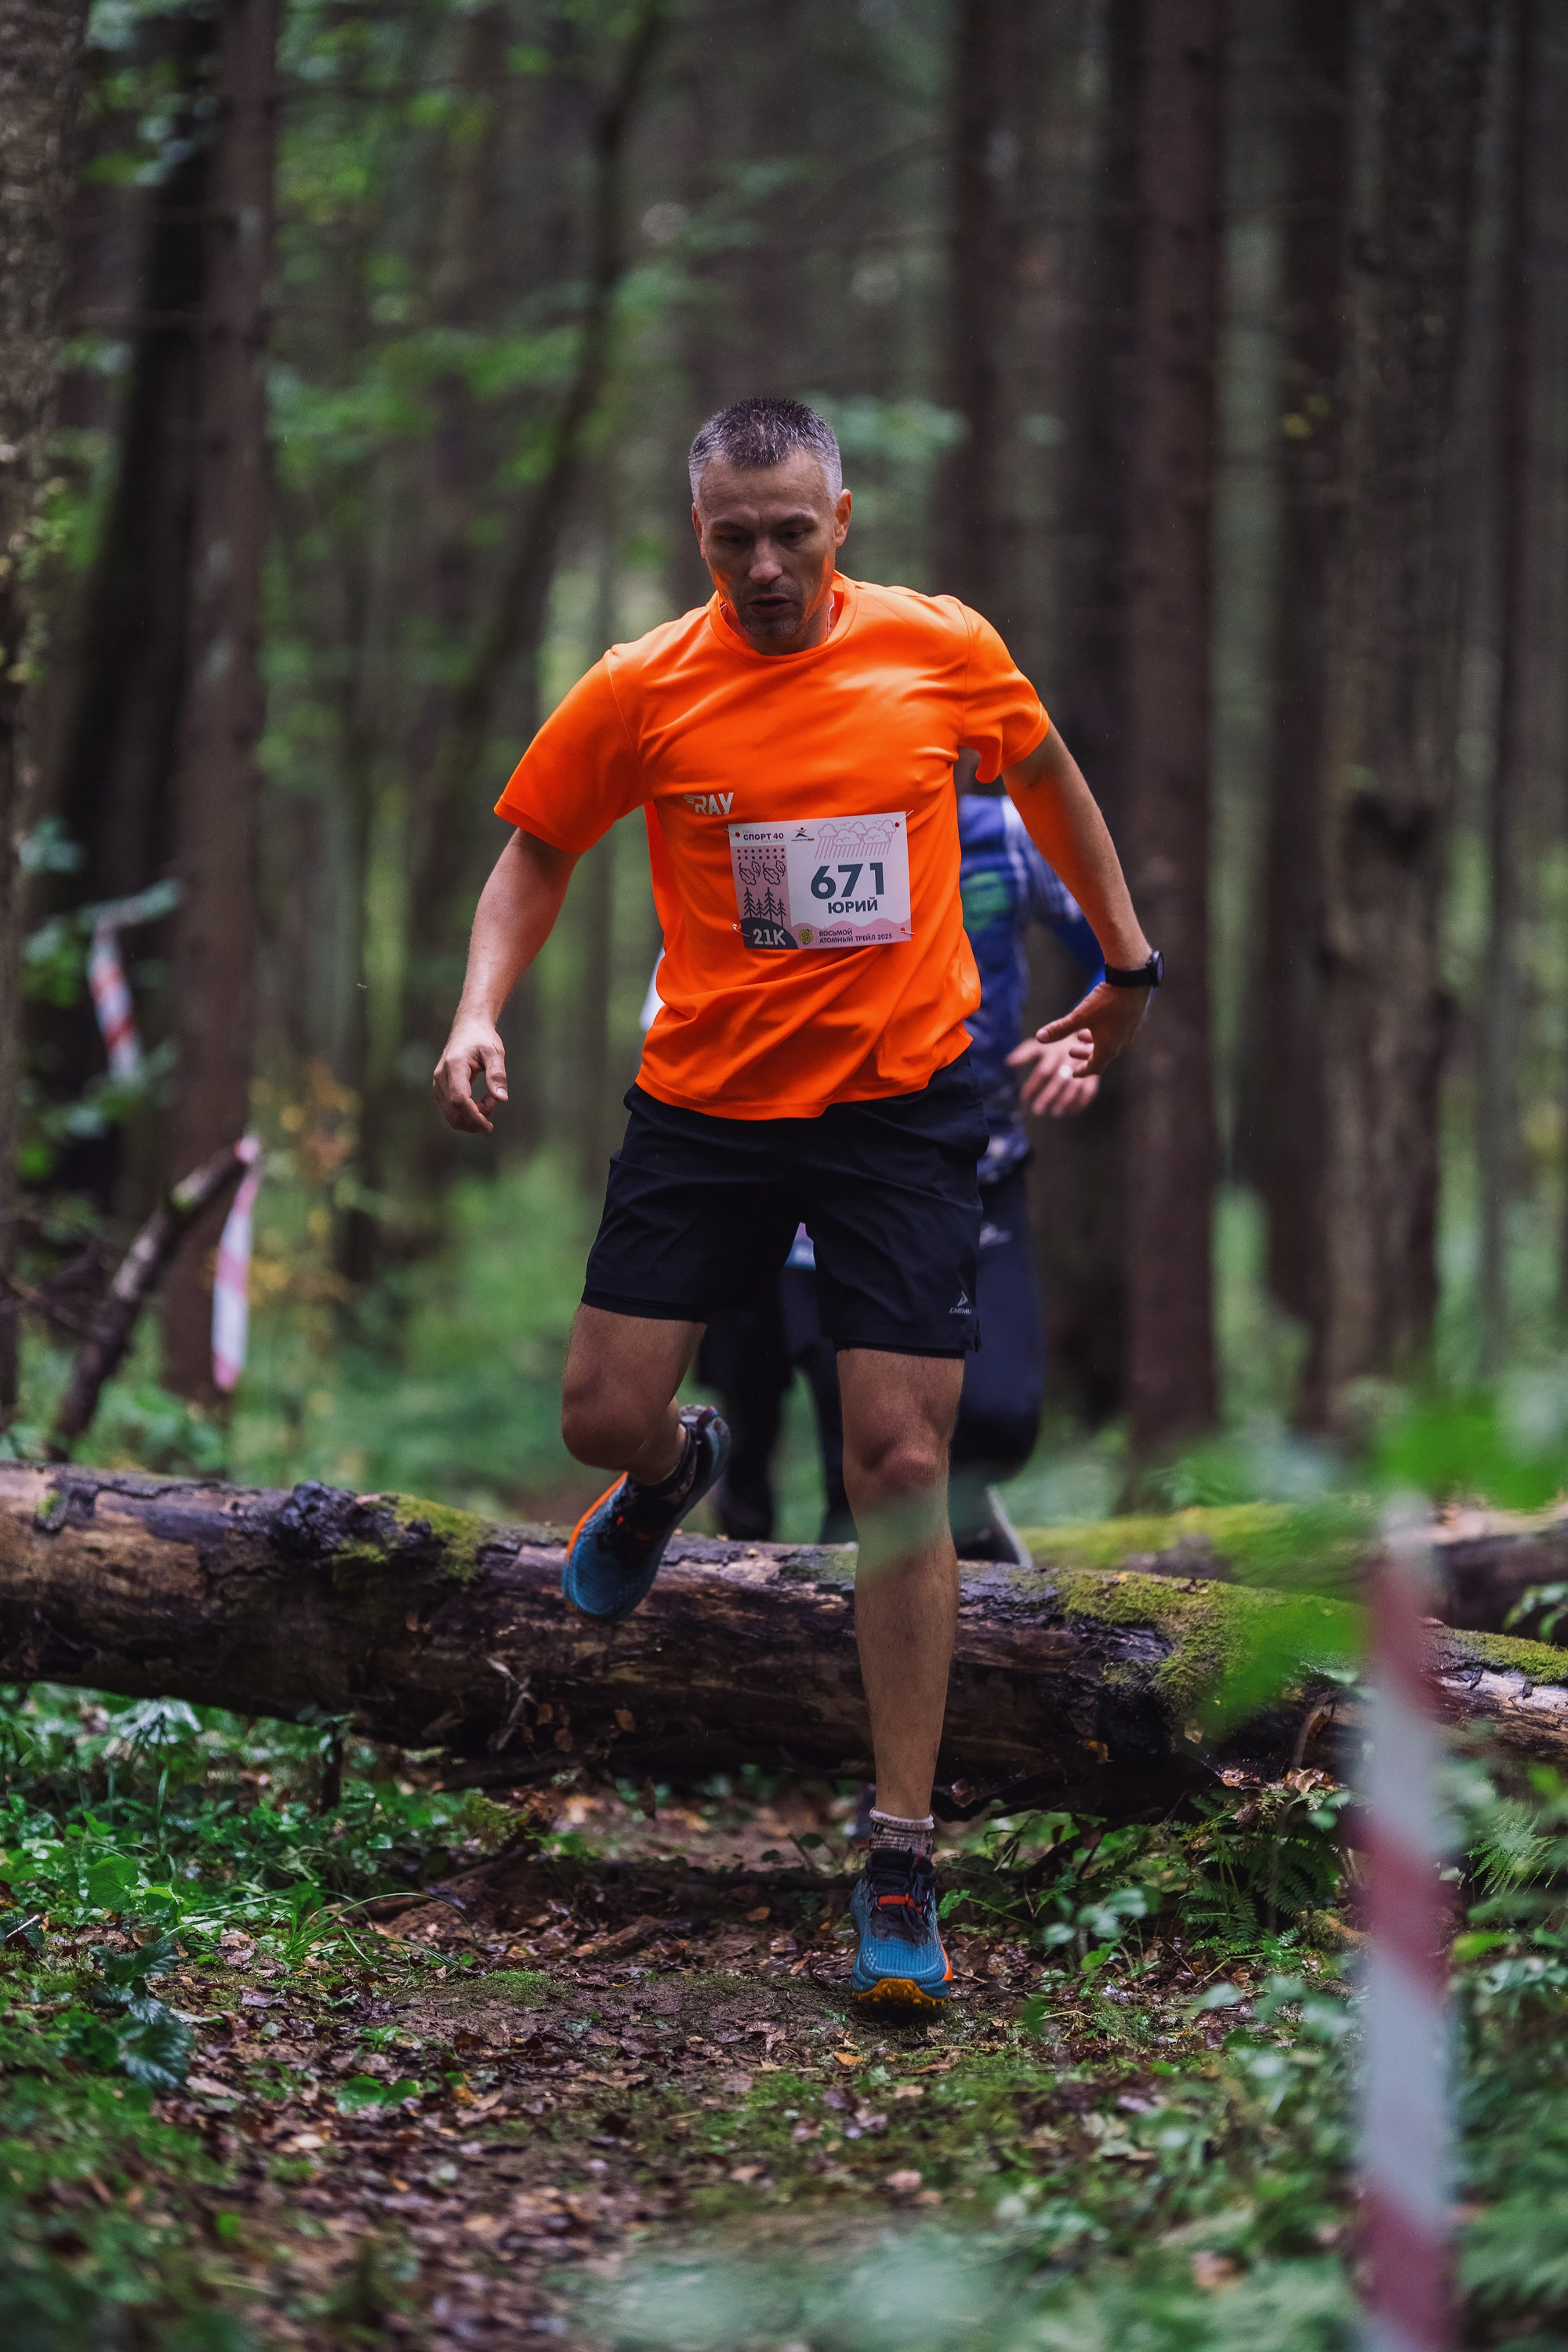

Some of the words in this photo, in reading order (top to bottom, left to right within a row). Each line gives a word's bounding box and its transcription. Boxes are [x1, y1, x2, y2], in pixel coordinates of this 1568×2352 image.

[683, 792, 734, 815] RAY
[811, 862, 884, 899] 671
[828, 897, 878, 914] ЮРИЙ
[819, 928, 852, 937] ВОСЬМОЙ
[819, 935, 853, 944] АТОМНЫЙ
